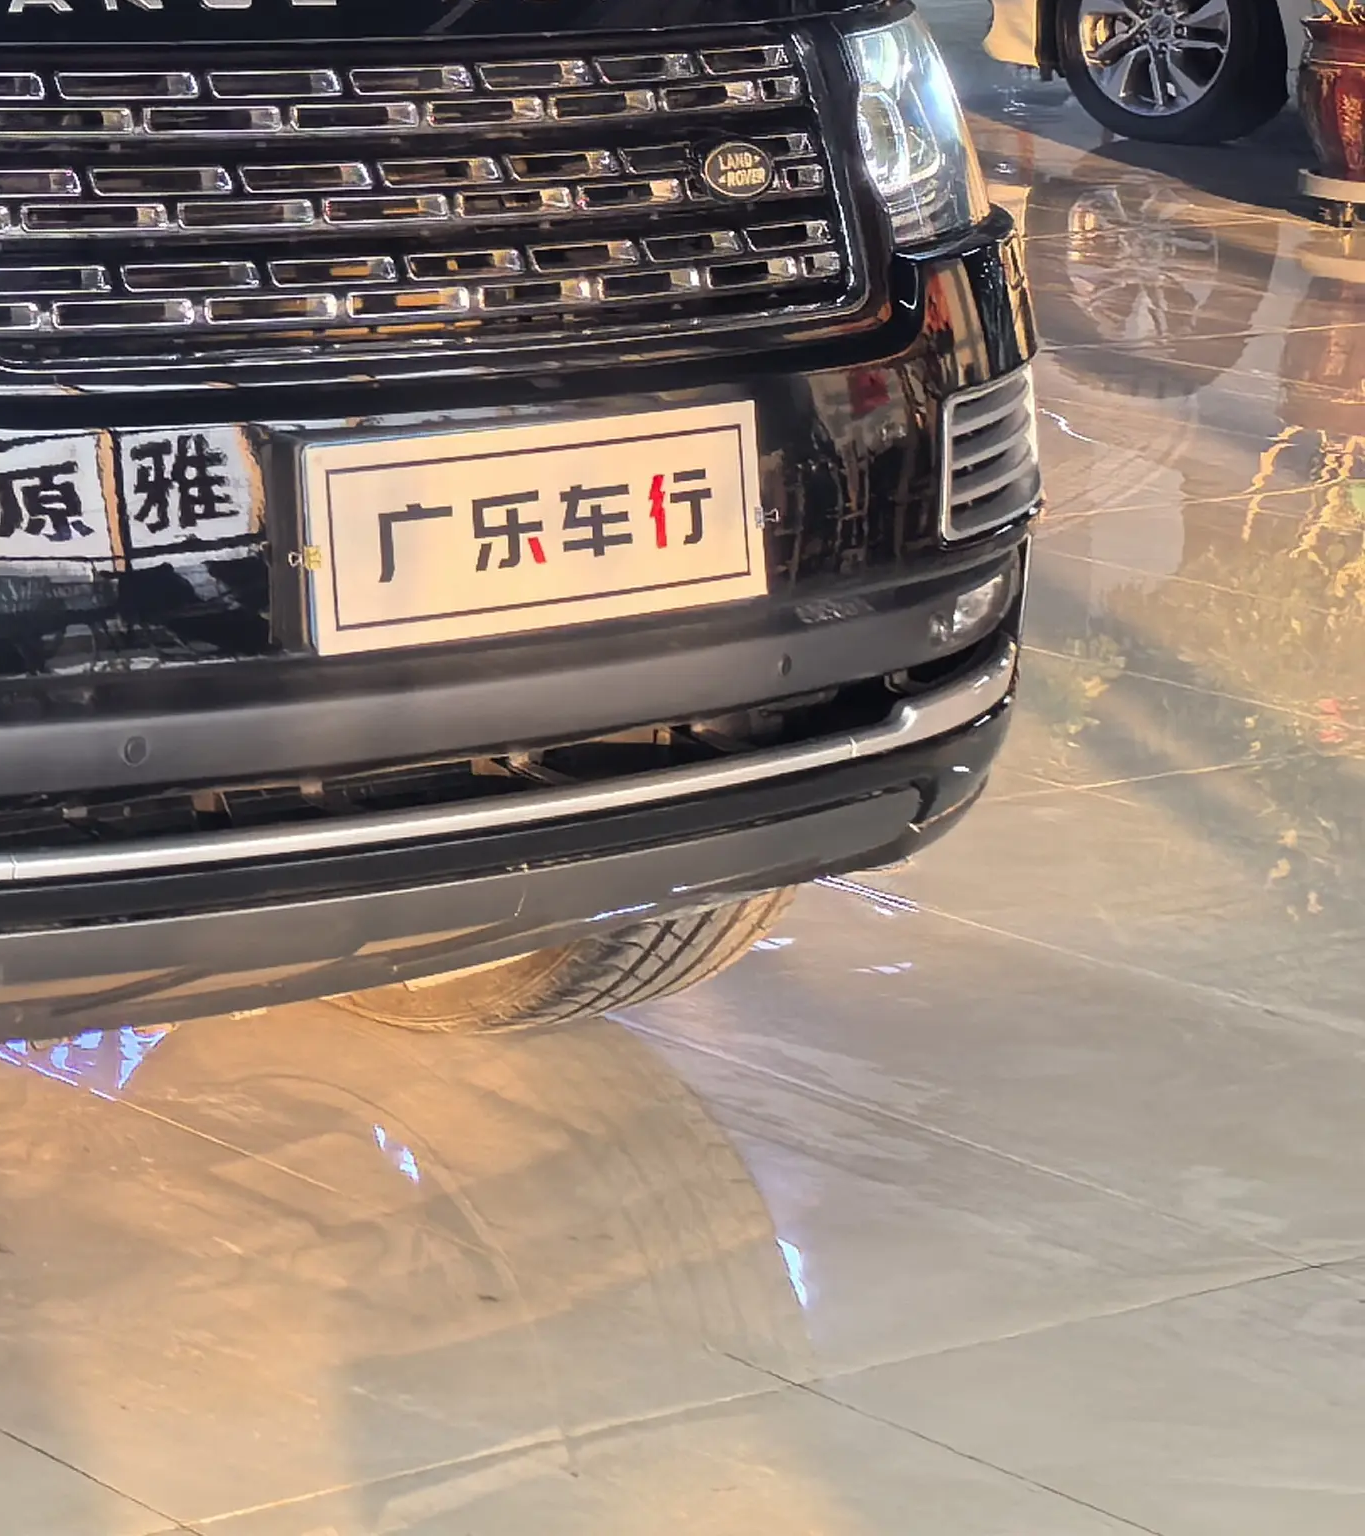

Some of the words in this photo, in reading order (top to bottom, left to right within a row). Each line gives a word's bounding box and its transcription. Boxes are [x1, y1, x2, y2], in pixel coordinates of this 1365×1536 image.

[718, 151, 753, 170] LAND
[727, 167, 766, 186] ROVER
[131, 434, 241, 533] 雅
[377, 468, 713, 584] 广乐车行
